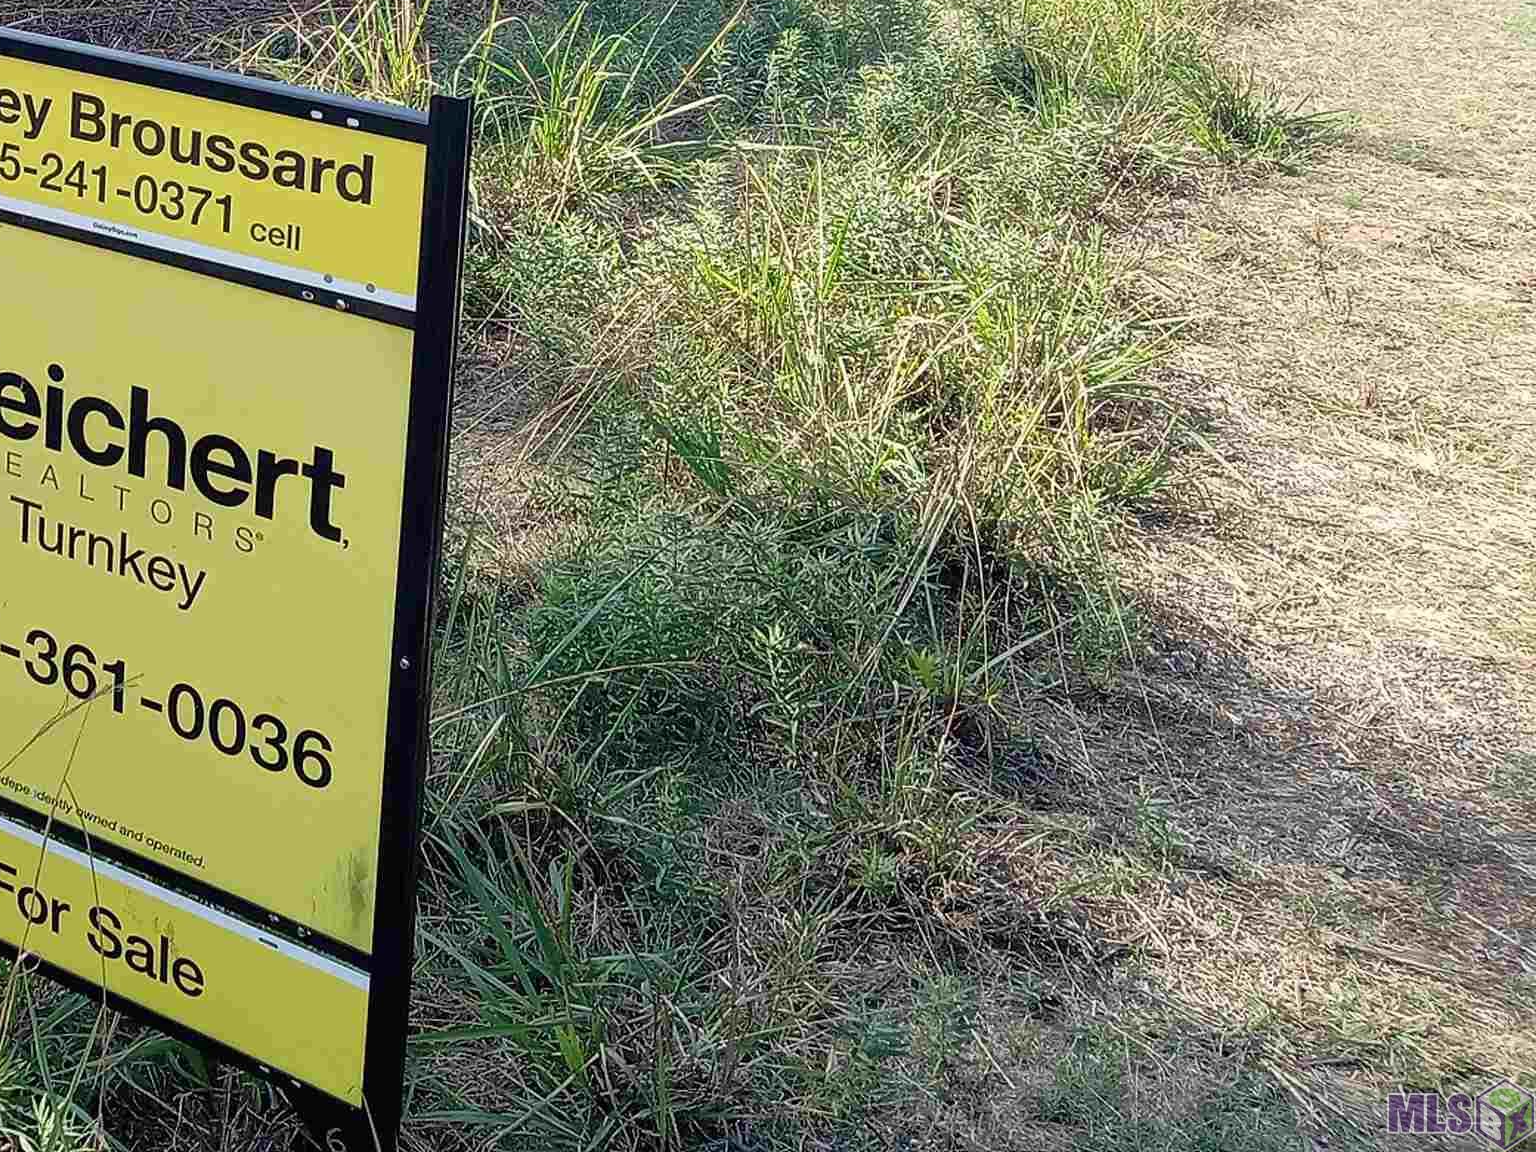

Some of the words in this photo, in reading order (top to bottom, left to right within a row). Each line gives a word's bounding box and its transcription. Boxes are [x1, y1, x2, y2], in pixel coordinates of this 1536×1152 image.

[71, 91, 374, 205] Broussard
[250, 221, 302, 251] cell
[10, 494, 206, 610] Turnkey
[76, 808, 117, 832] owned
[119, 825, 144, 843] and
[87, 905, 205, 998] Sale
